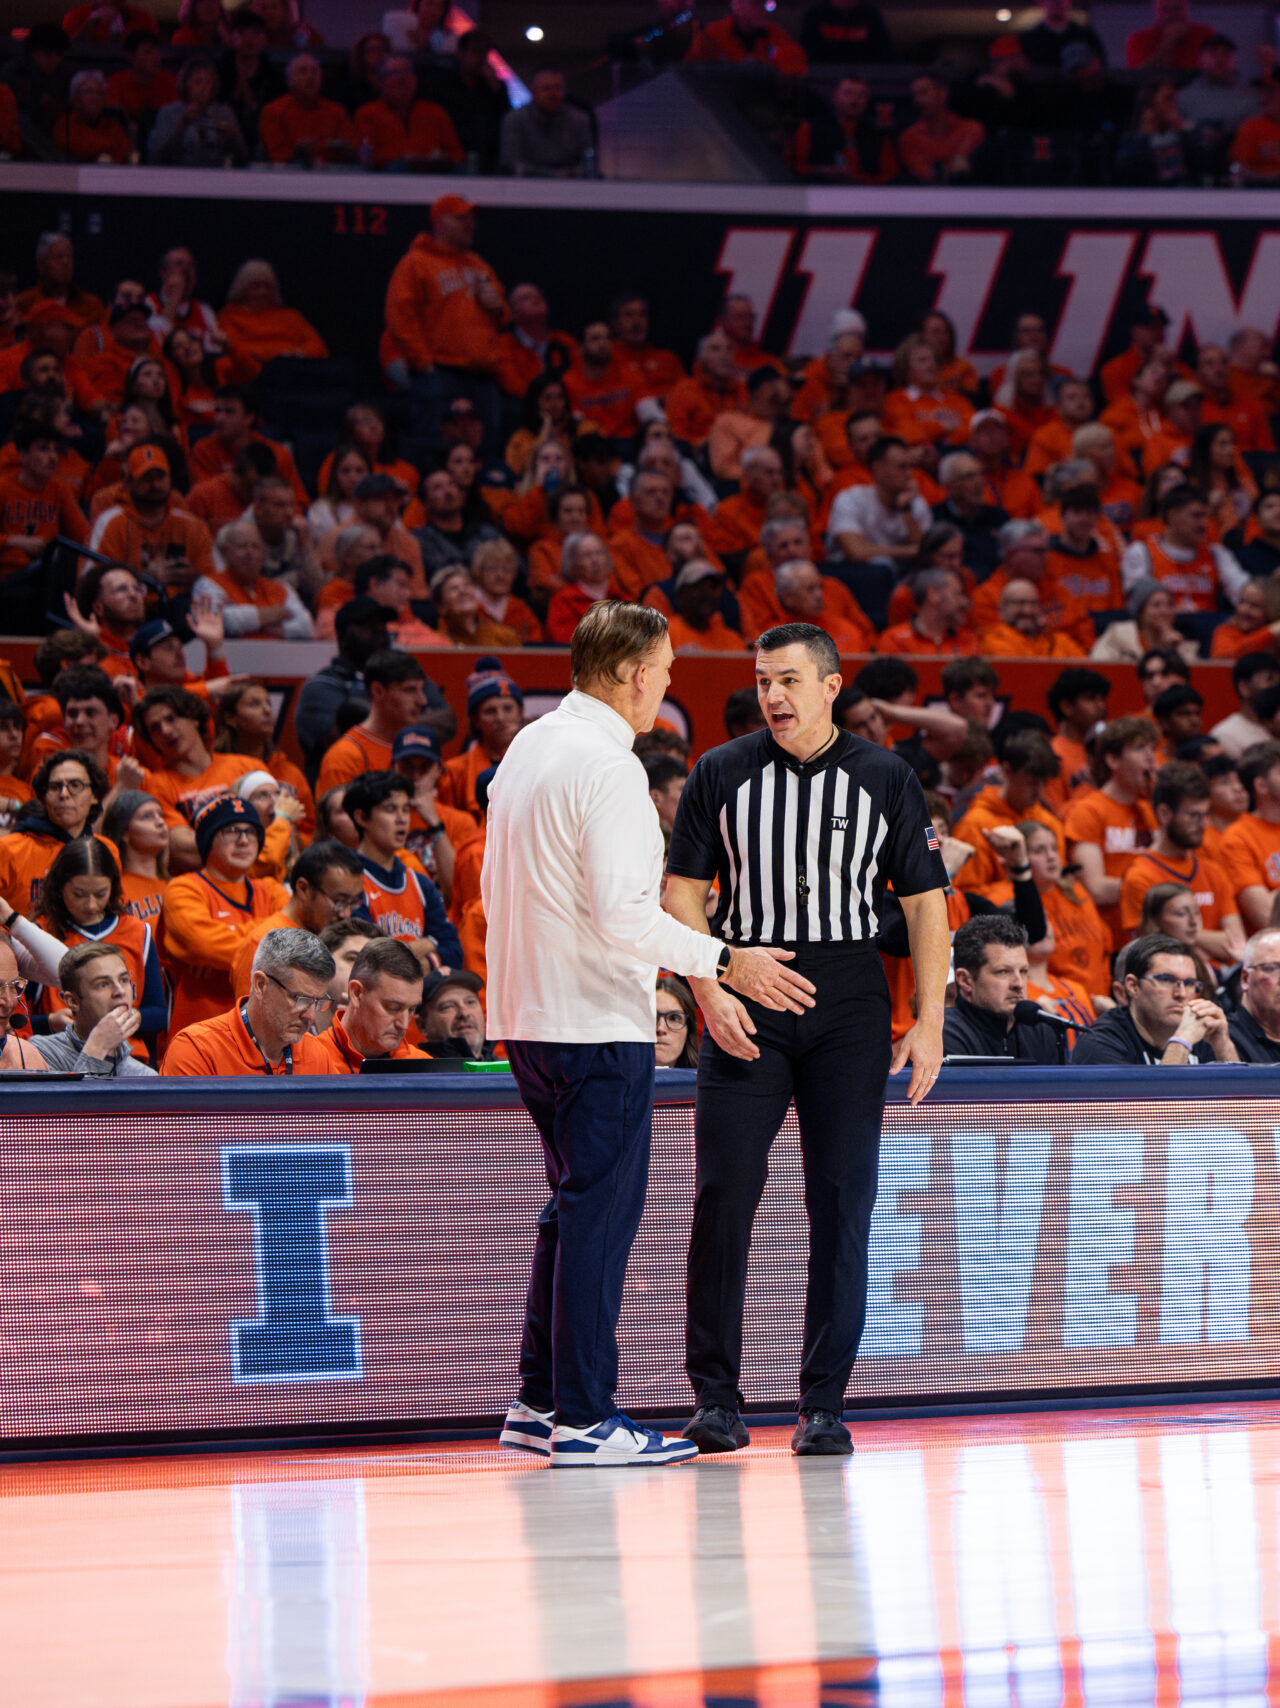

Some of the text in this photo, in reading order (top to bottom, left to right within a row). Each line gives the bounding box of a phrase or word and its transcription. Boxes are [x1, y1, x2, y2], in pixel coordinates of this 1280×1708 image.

[334, 205, 388, 237] 112
[831, 817, 849, 830] TW
[220, 1144, 363, 1384] I
